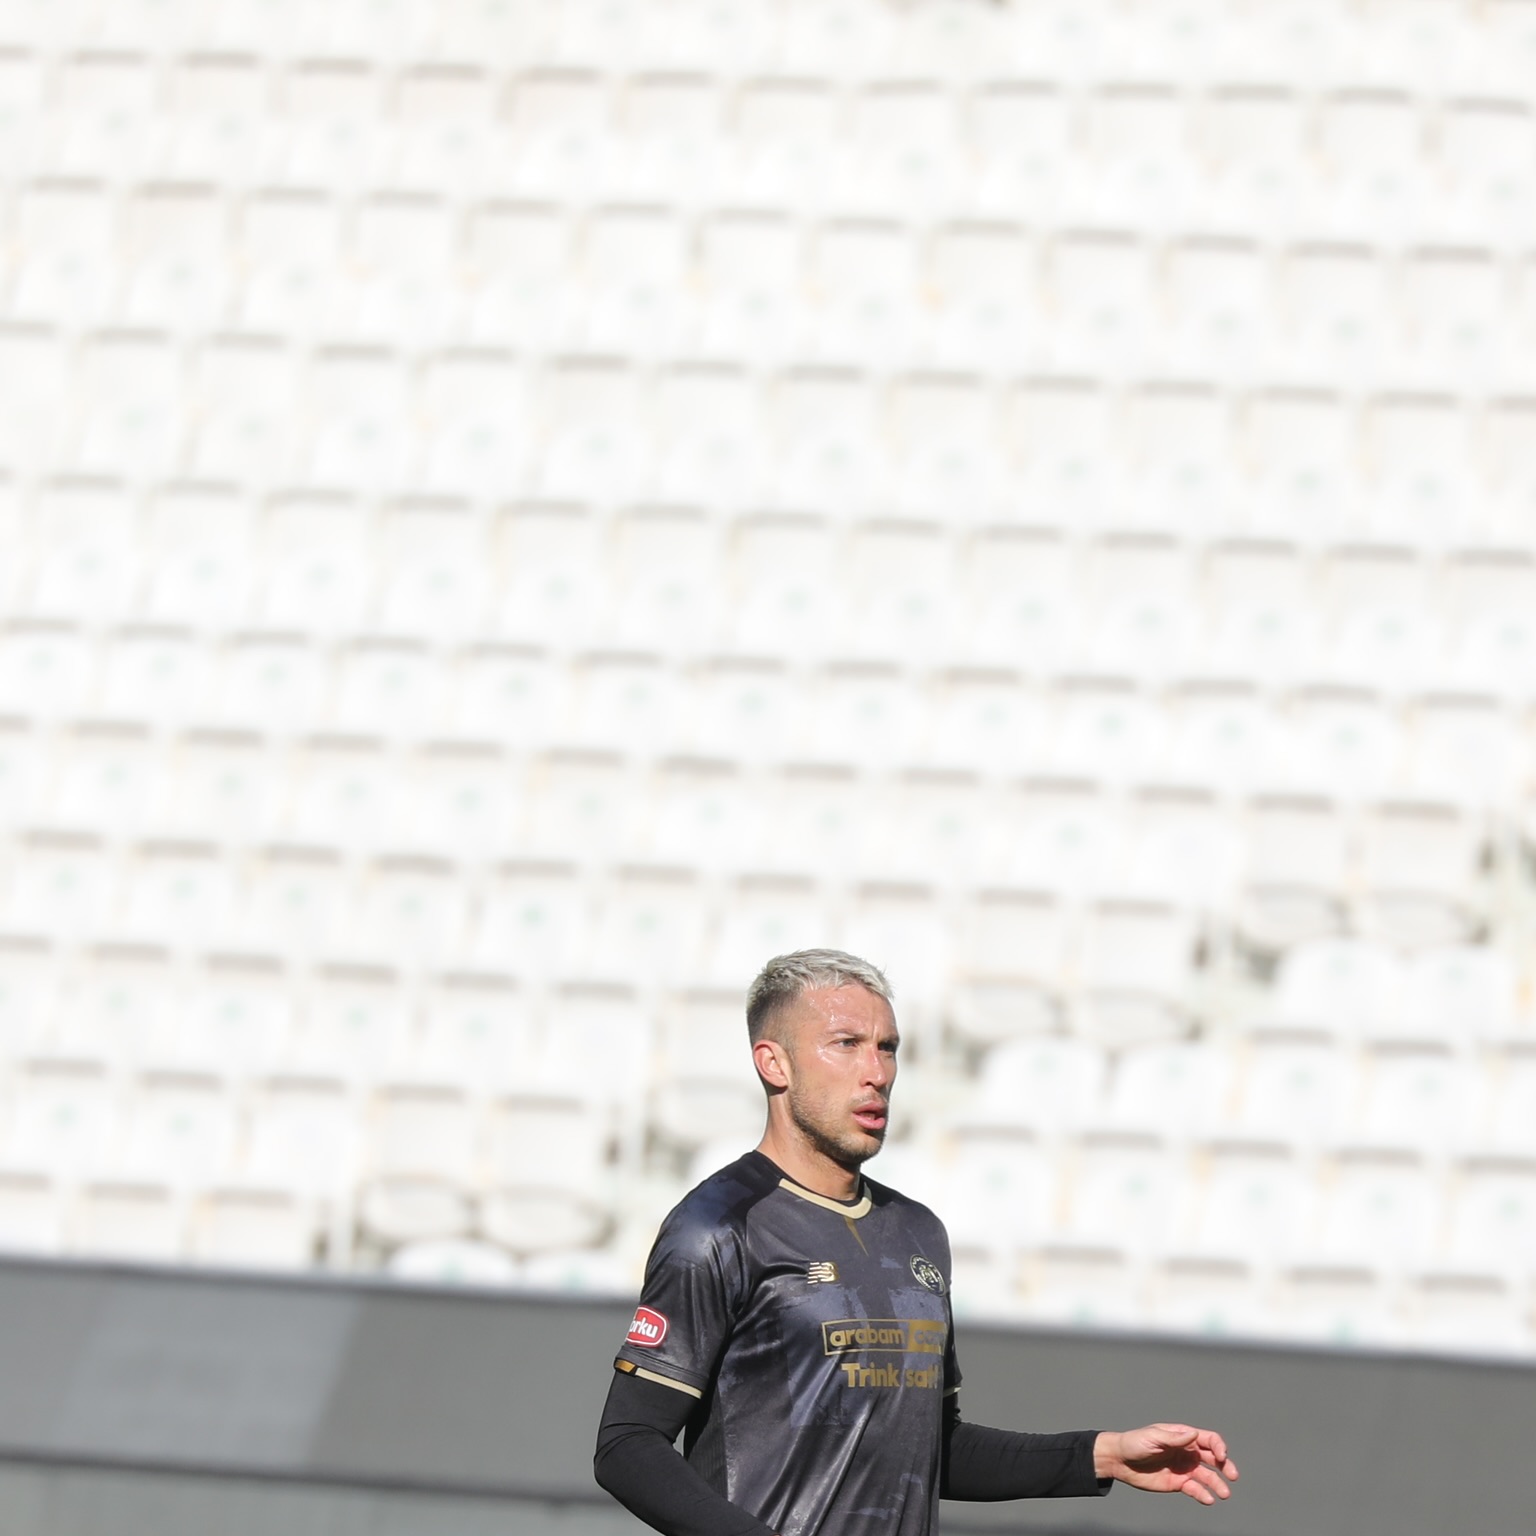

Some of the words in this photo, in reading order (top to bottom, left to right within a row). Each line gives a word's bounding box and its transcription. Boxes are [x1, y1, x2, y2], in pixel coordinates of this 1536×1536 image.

[628, 1316, 659, 1339] orku
[829, 1328, 904, 1347] arabam
[841, 1362, 900, 1388] Trink
